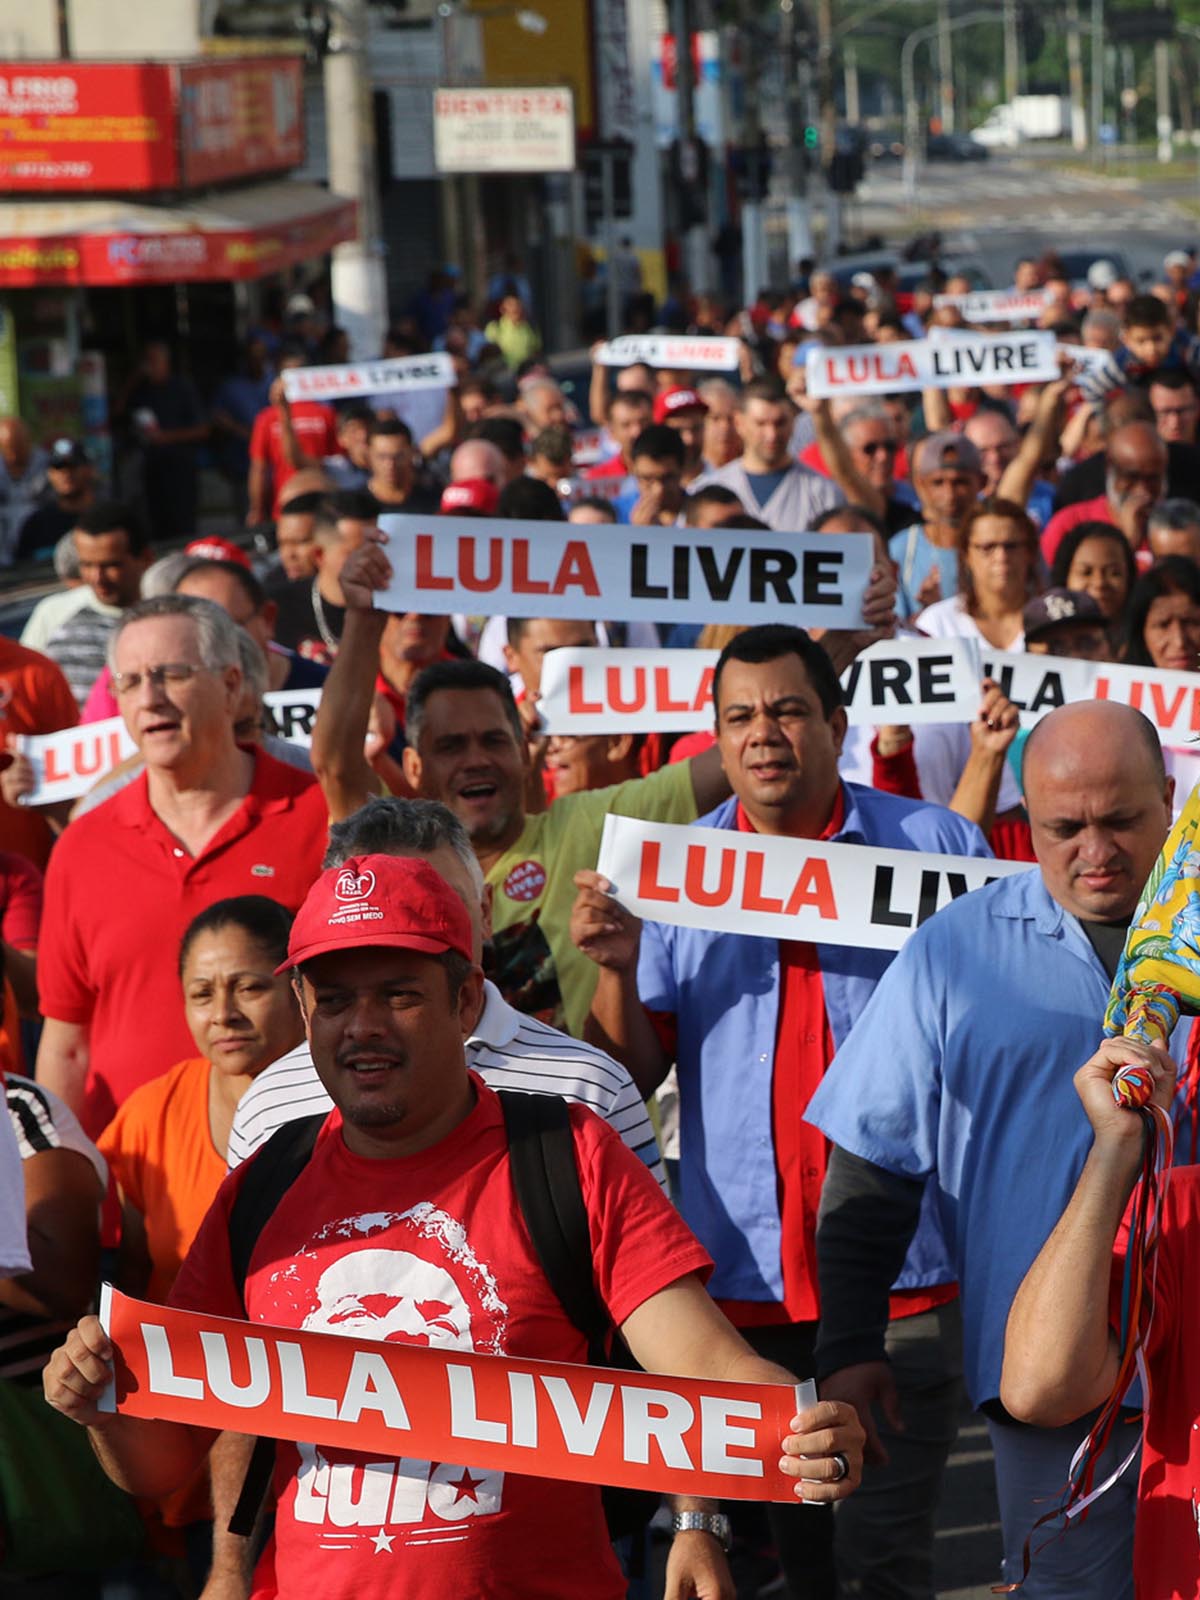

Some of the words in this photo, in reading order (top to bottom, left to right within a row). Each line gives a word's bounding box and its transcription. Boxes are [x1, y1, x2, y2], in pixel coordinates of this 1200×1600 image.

[435, 89, 569, 117] DENTISTA
[298, 371, 363, 392] LULA
[369, 364, 440, 384] LIVRE
[826, 353, 919, 385] LULA
[933, 343, 1039, 377] LIVRE
[416, 535, 600, 597] LULA
[631, 544, 844, 605] LIVRE
[636, 841, 839, 921] LULA
[346, 914, 361, 922] SEM
[362, 912, 384, 920] MEDO
[141, 1323, 411, 1430] LULA
[445, 1363, 765, 1477] LIVRE
